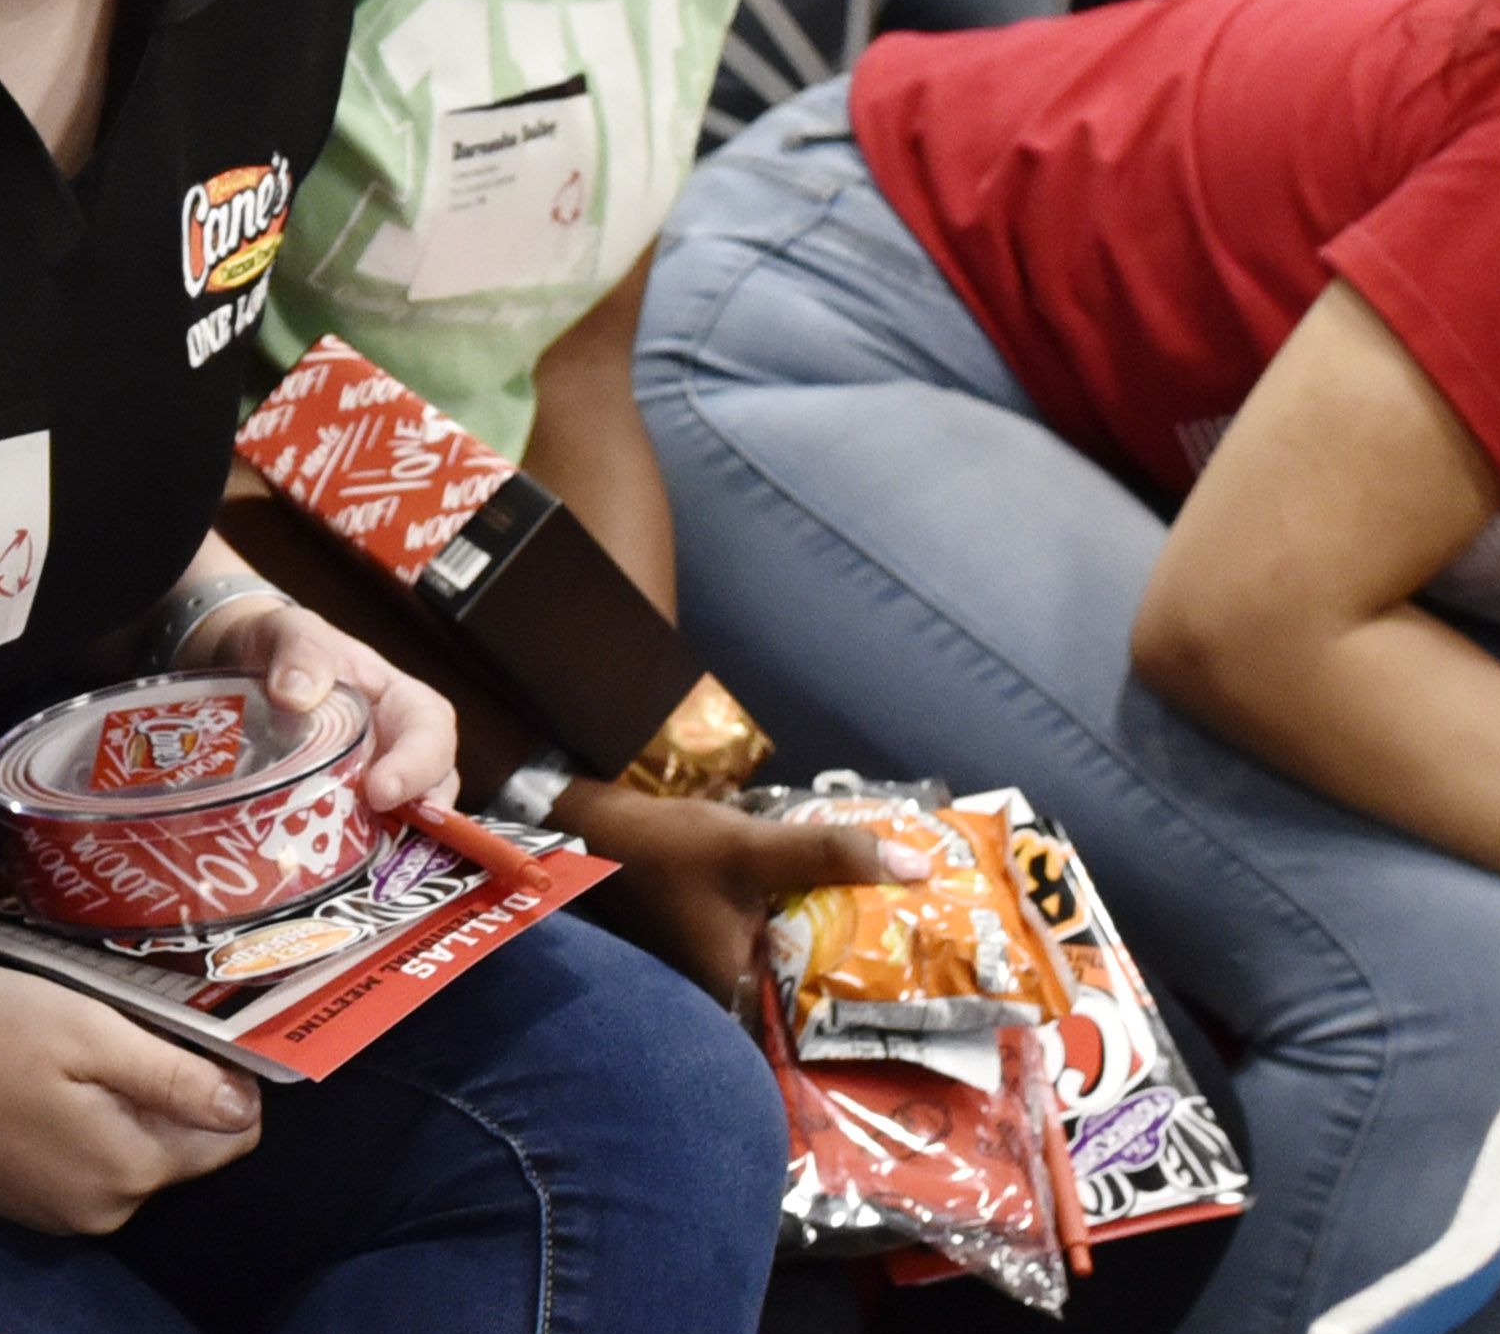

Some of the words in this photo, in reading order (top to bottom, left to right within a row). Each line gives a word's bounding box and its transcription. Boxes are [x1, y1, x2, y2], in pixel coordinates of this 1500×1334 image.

[182, 151, 290, 299] Cane's
[186, 303, 234, 368] ONE
[72, 832, 181, 915] WOOF!
[401, 892, 543, 980] DALLAS
[287, 977, 382, 1044] MEETING
